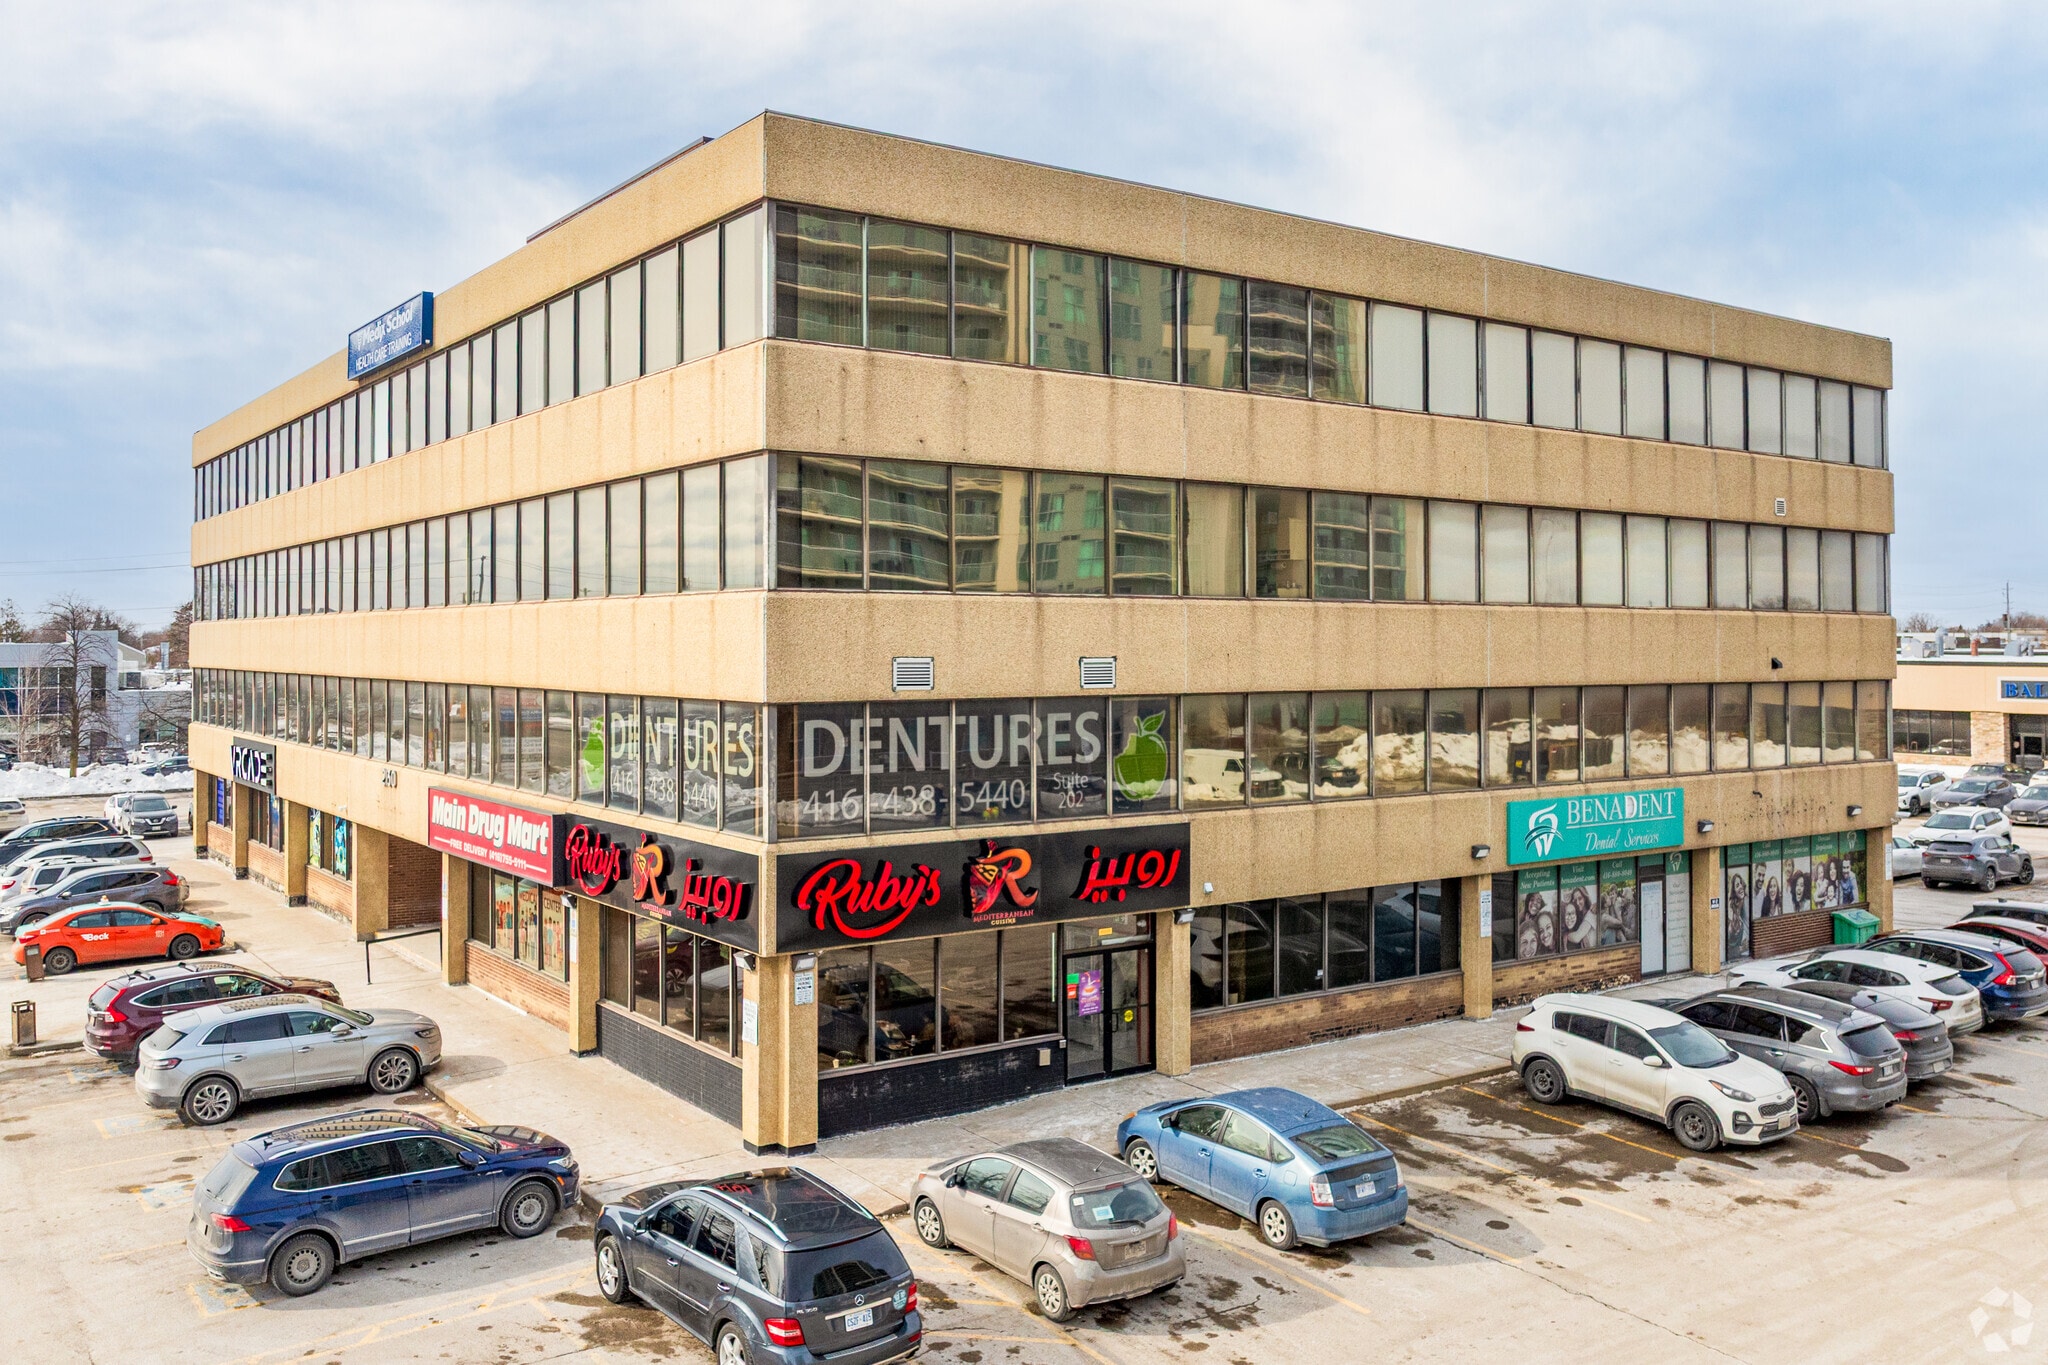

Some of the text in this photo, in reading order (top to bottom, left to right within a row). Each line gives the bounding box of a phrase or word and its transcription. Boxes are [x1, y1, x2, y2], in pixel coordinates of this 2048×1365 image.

[386, 302, 414, 333] School
[355, 332, 412, 371] HEALTH CARE TRAINING
[611, 712, 754, 778] DENTURES
[804, 711, 1101, 778] DENTURES
[612, 770, 717, 811] 416-4385440
[1053, 771, 1089, 790] Suite
[1058, 790, 1084, 809] 202
[1567, 791, 1676, 825] BENADENT
[432, 795, 549, 857] Main Drug Mart
[1585, 825, 1659, 852] Dental Services
[450, 838, 463, 850] FREE
[463, 842, 488, 858] DELIVERY
[565, 823, 620, 897] Ruby's
[1520, 880, 1555, 889] New Patients
[1524, 870, 1551, 879] Accepting
[544, 897, 562, 913] CENTER
[797, 857, 942, 939] Ruby's
[973, 909, 1034, 923] MEDITERRANEAN
